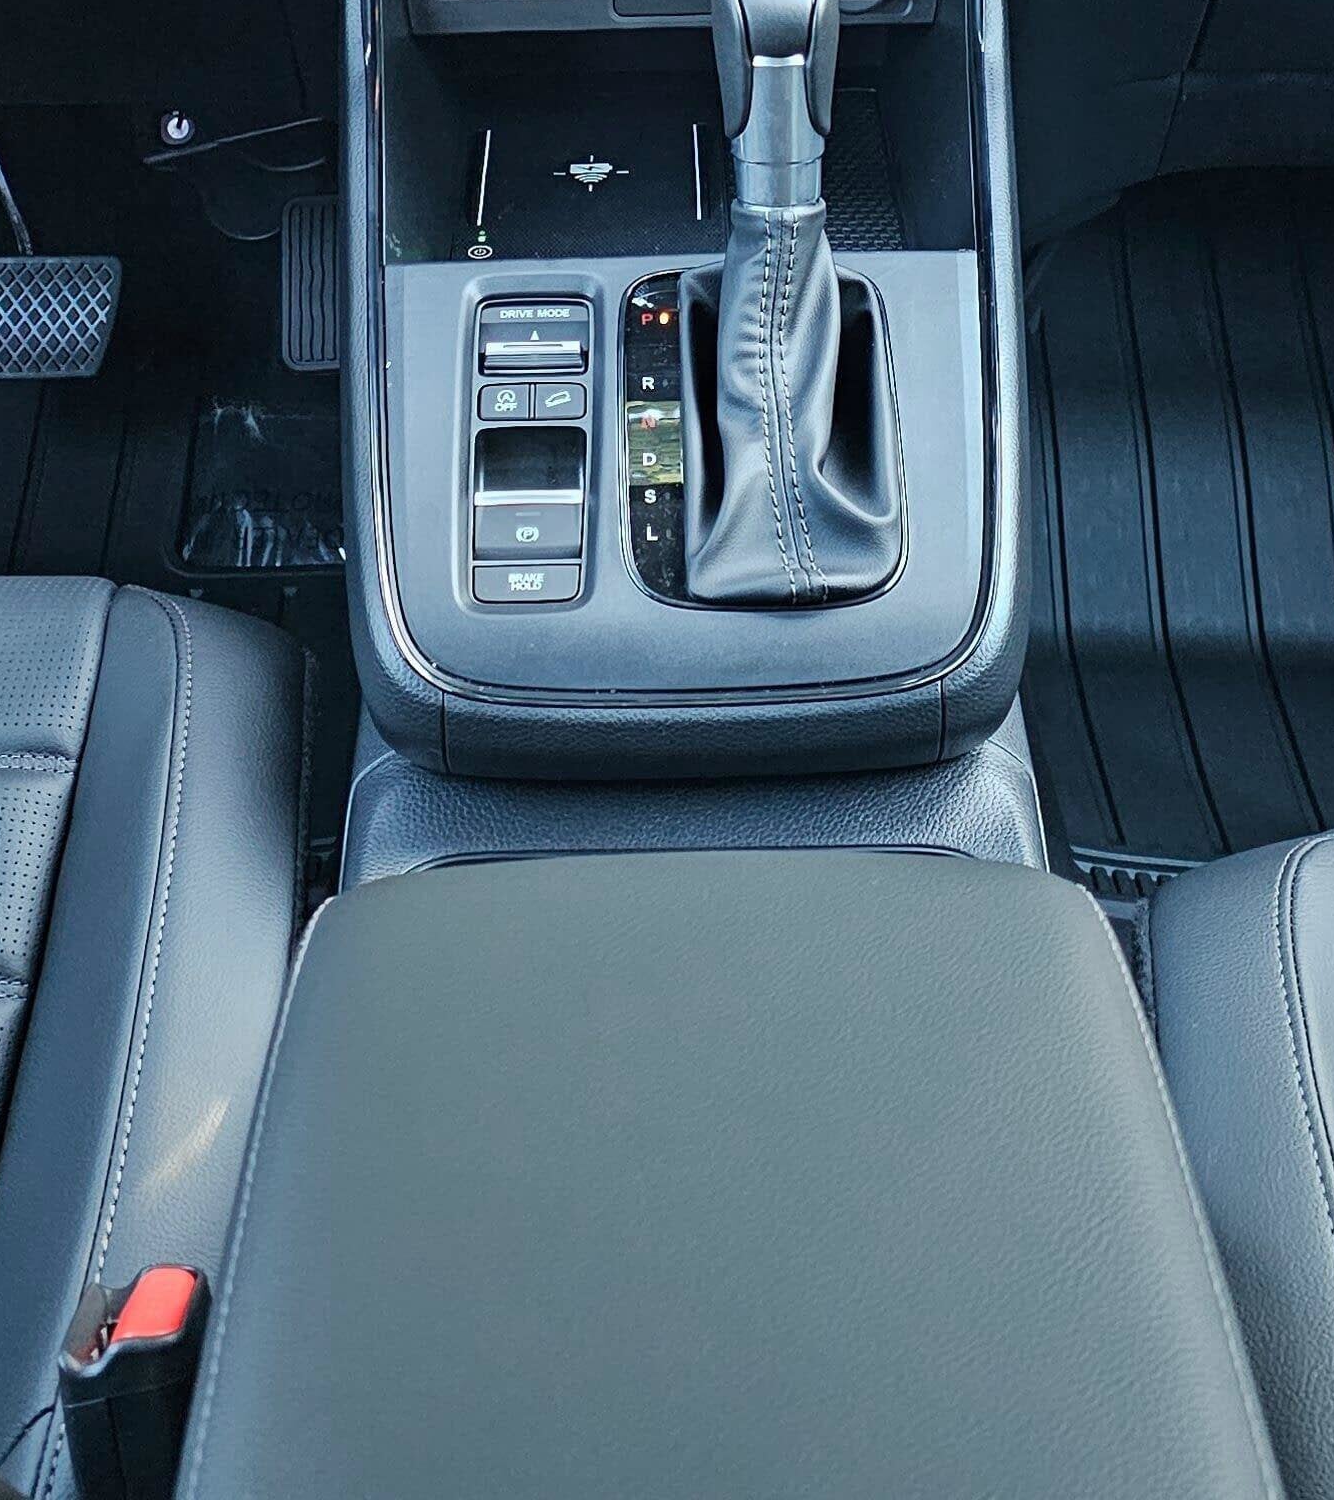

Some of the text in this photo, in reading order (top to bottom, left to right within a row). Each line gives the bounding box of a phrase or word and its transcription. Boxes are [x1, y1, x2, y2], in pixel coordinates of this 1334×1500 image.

[499, 308, 571, 319] DRIVE MODE
[641, 313, 654, 326] P
[642, 377, 655, 390] R
[495, 402, 518, 412] OFF
[642, 416, 655, 429] N
[643, 453, 656, 466] D
[644, 490, 657, 503] S
[646, 527, 658, 541] L
[508, 573, 545, 583] BRAKE
[510, 581, 542, 591] HOLD
